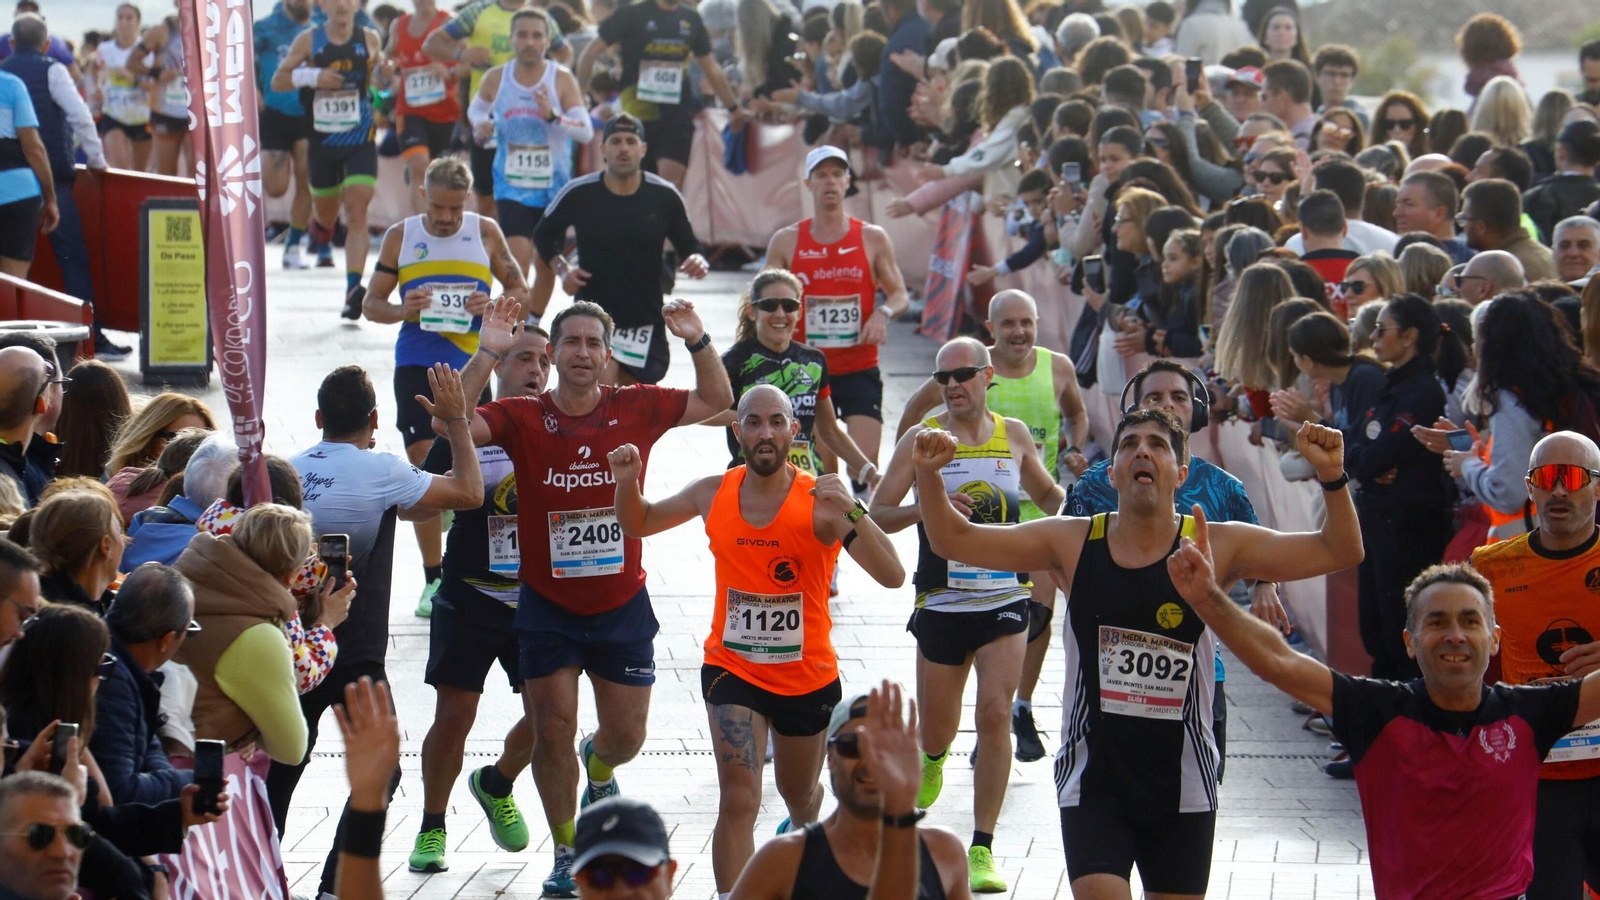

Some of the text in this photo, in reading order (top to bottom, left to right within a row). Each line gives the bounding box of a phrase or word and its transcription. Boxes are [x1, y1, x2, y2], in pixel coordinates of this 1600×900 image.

[324, 98, 356, 114] 1391
[517, 154, 550, 168] 1158
[819, 308, 859, 324] 1239
[302, 488, 322, 502] ker
[590, 510, 616, 518] MARATÓ
[508, 530, 516, 550] 1
[568, 522, 621, 546] 2408
[736, 538, 780, 548] GIVOVA
[1504, 585, 1529, 594] FASTER
[742, 608, 800, 632] 1120
[1102, 630, 1120, 644] 38
[1122, 633, 1148, 643] MEDIA
[1118, 650, 1189, 682] 3092
[1123, 681, 1143, 689] MONTES
[1152, 707, 1180, 715] IMDECO
